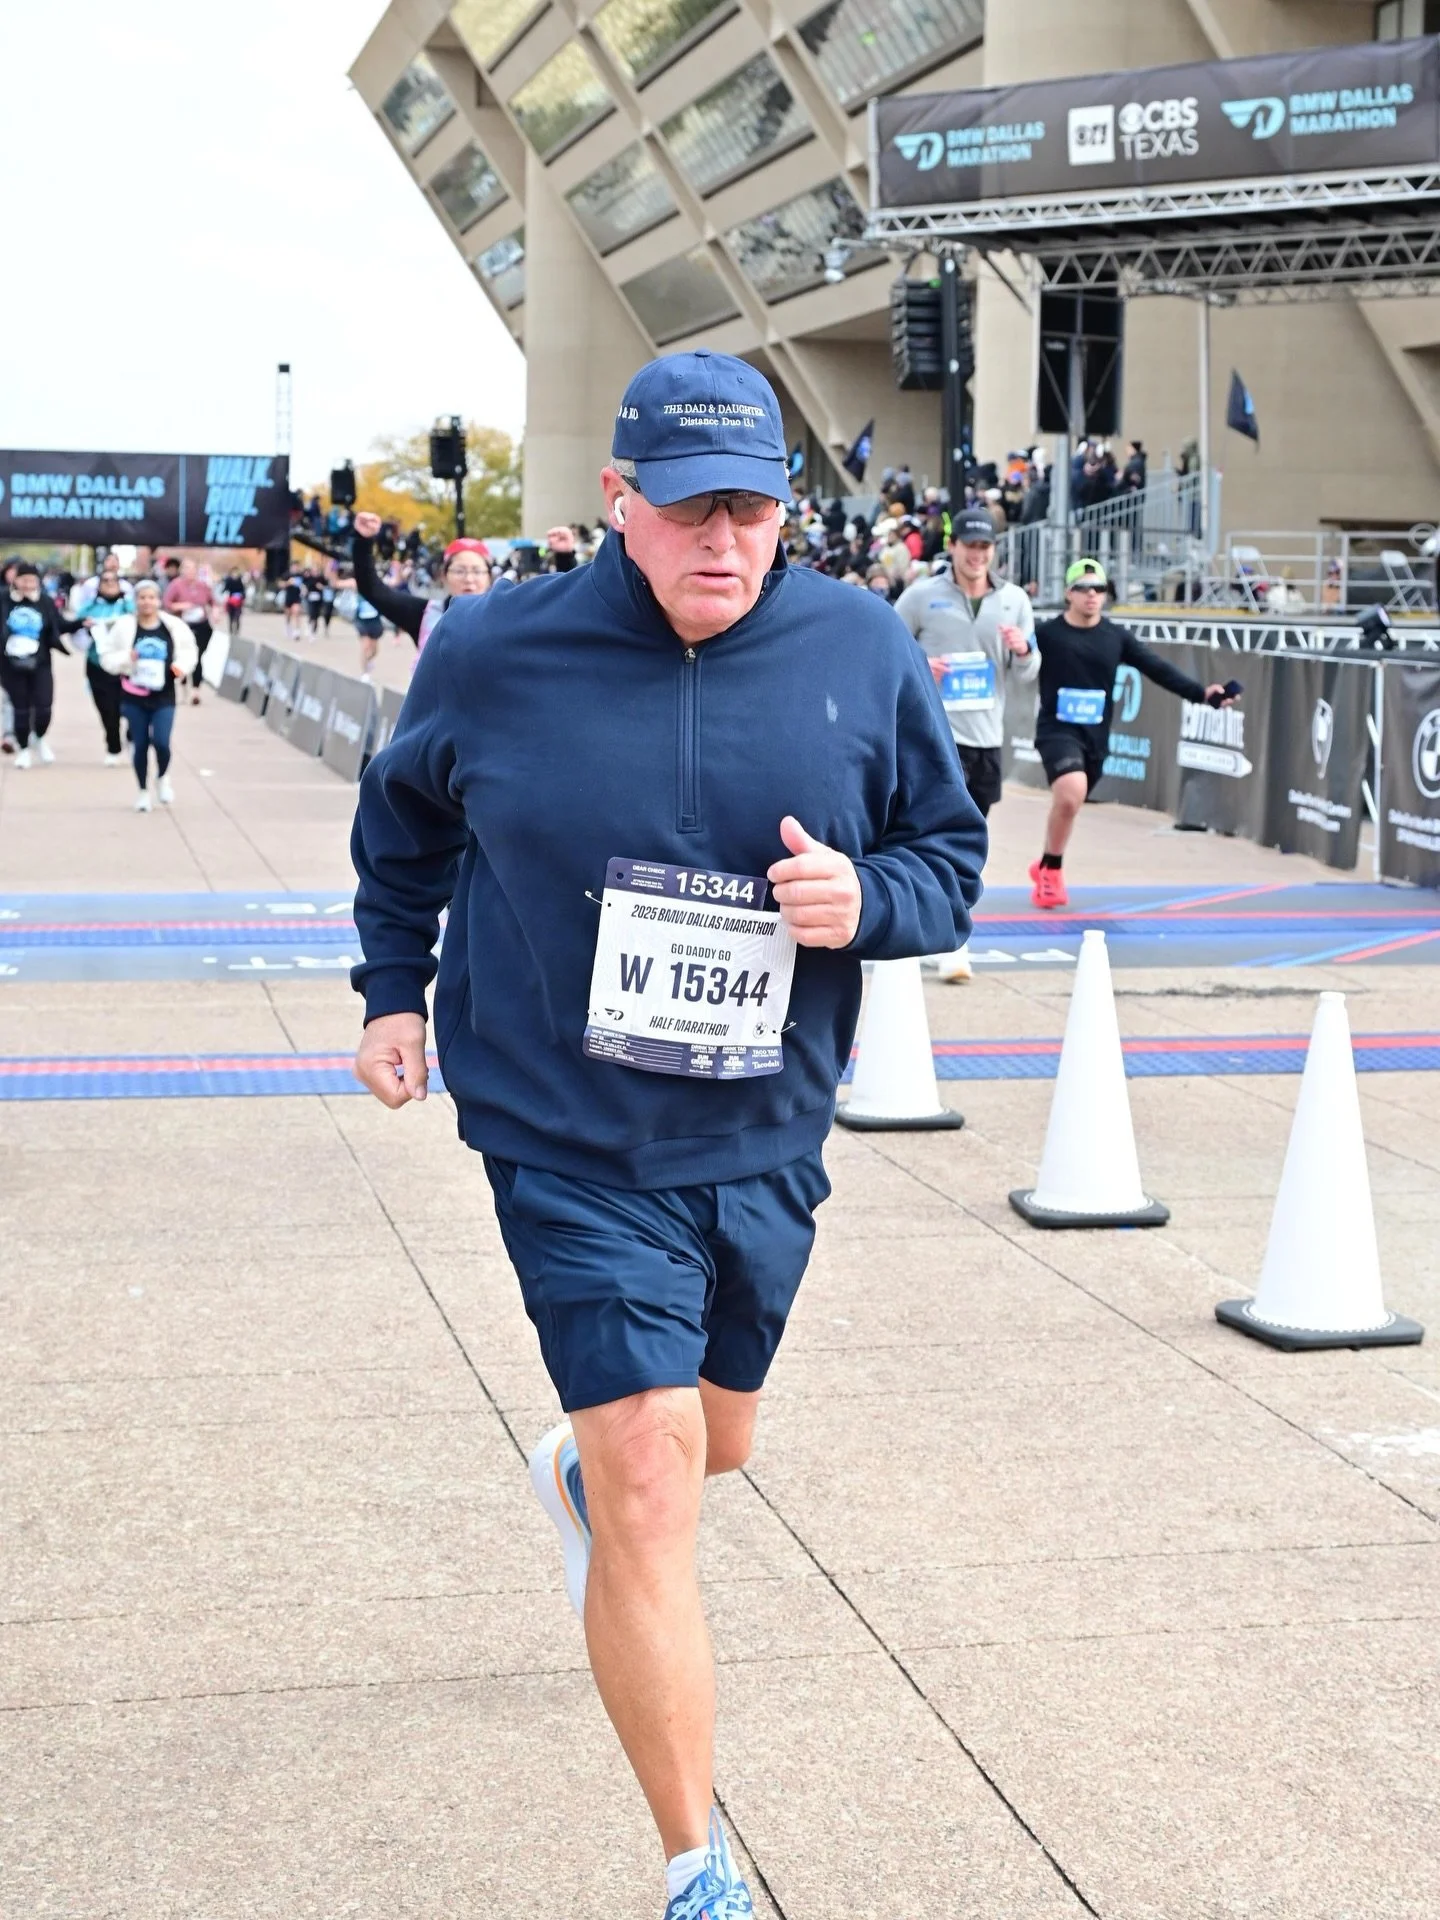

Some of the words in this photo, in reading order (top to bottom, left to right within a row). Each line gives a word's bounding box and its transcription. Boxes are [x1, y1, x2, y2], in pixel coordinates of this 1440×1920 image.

[1290, 91, 1338, 115] BMW
[1339, 83, 1414, 109] DALLAS
[1143, 97, 1199, 132] CBS
[1290, 106, 1397, 136] MARATHON
[947, 128, 985, 148] BMW
[986, 120, 1045, 144] DALLAS
[1119, 129, 1200, 160] TEXAS
[947, 142, 1032, 168] MARATHON
[664, 405, 683, 414] THE
[685, 404, 707, 414] DAD
[708, 404, 716, 413] &
[718, 404, 766, 416] DAUGHTER
[680, 417, 719, 426] Distance
[722, 418, 741, 426] Duo
[10, 473, 73, 495] BMW
[75, 475, 165, 498] DALLAS
[206, 456, 274, 487] WALK.
[10, 496, 144, 519] MARATHON
[205, 486, 258, 516] RUN.
[204, 515, 244, 543] FLY.
[632, 865, 647, 873] GEAR
[647, 867, 666, 875] CHECK
[676, 872, 754, 903] 15344
[631, 904, 658, 920] 2025
[658, 907, 688, 923] BMW
[686, 912, 722, 930] DALLAS
[722, 917, 777, 936] MARATHON
[671, 943, 684, 955] GO
[686, 945, 717, 959] DADDY
[718, 949, 731, 961] GO
[620, 953, 654, 994] W
[670, 961, 770, 1007] 15344
[649, 1015, 674, 1030] HALF
[673, 1018, 729, 1036] MARATHON
